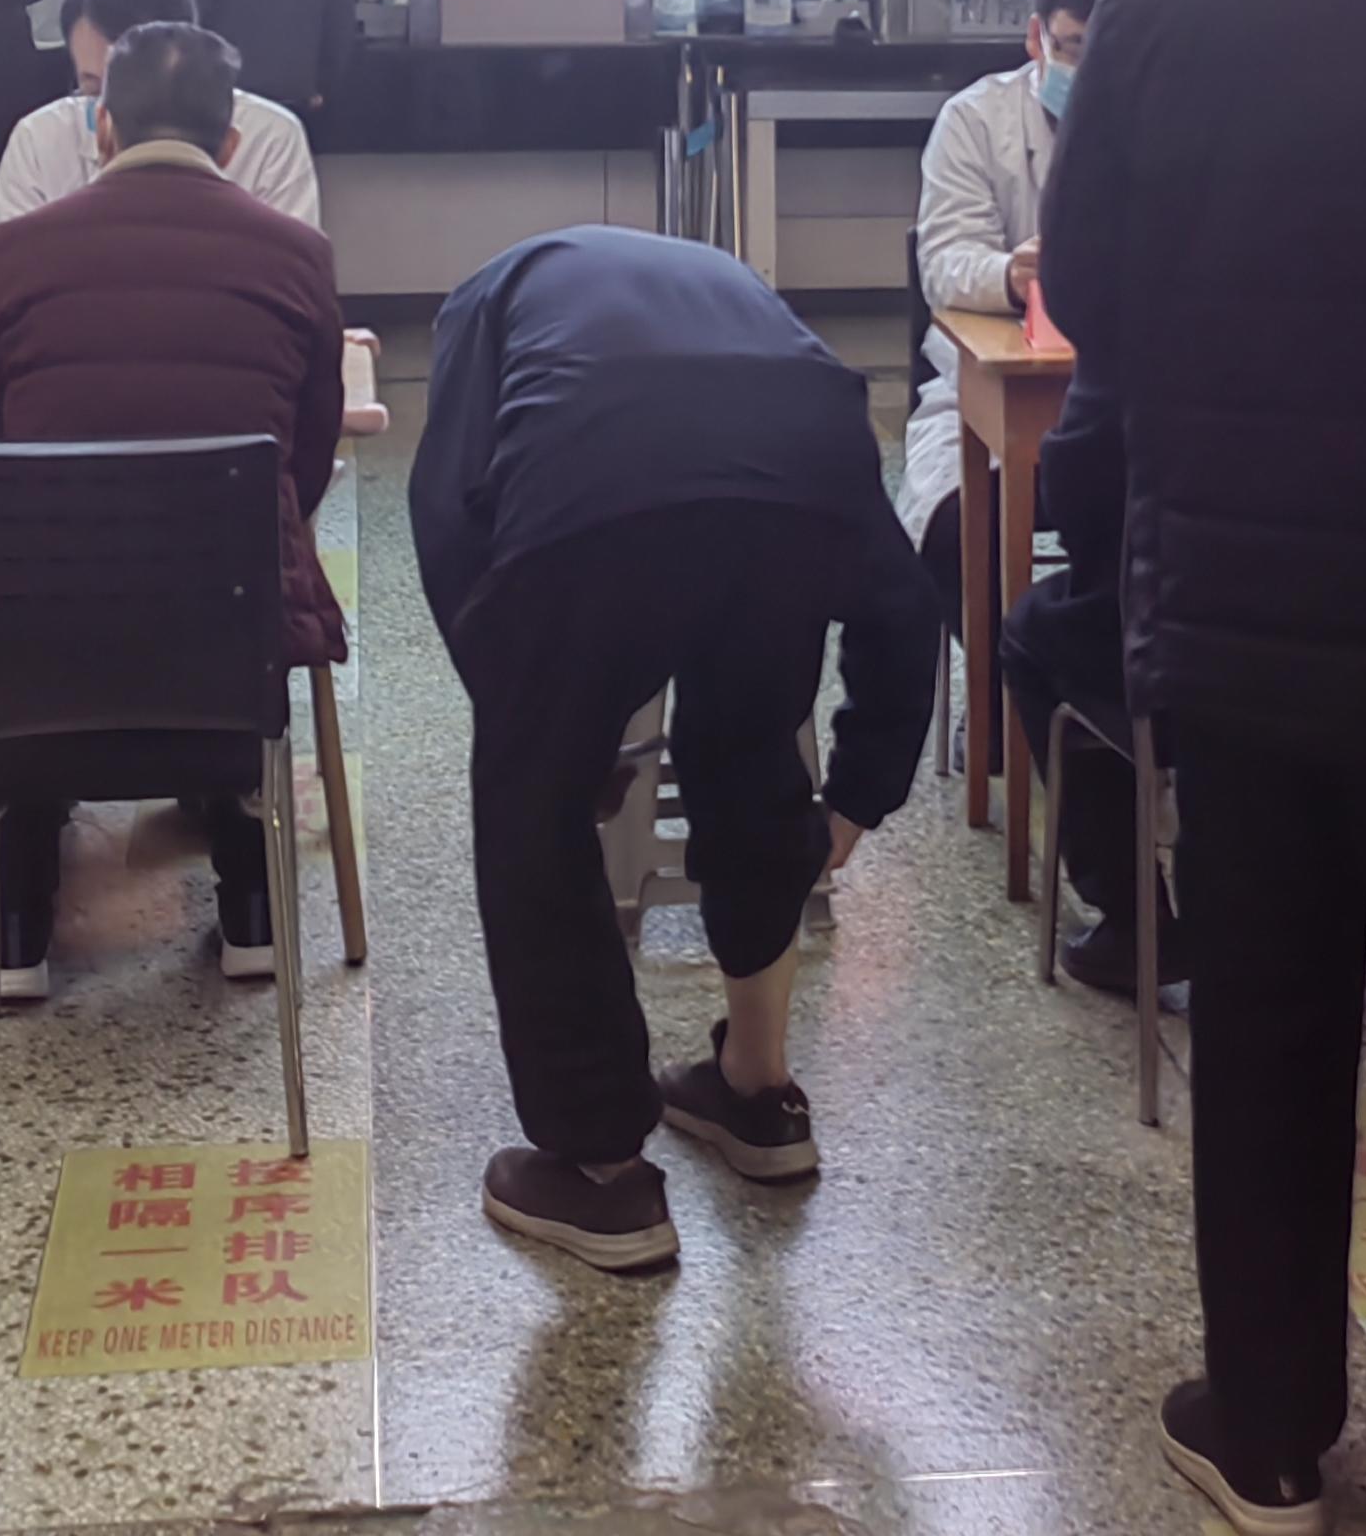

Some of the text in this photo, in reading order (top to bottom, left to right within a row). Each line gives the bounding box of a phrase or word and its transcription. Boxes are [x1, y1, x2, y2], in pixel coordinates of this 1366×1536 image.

[37, 1313, 357, 1359] KEEP ONE METER DISTANCE
